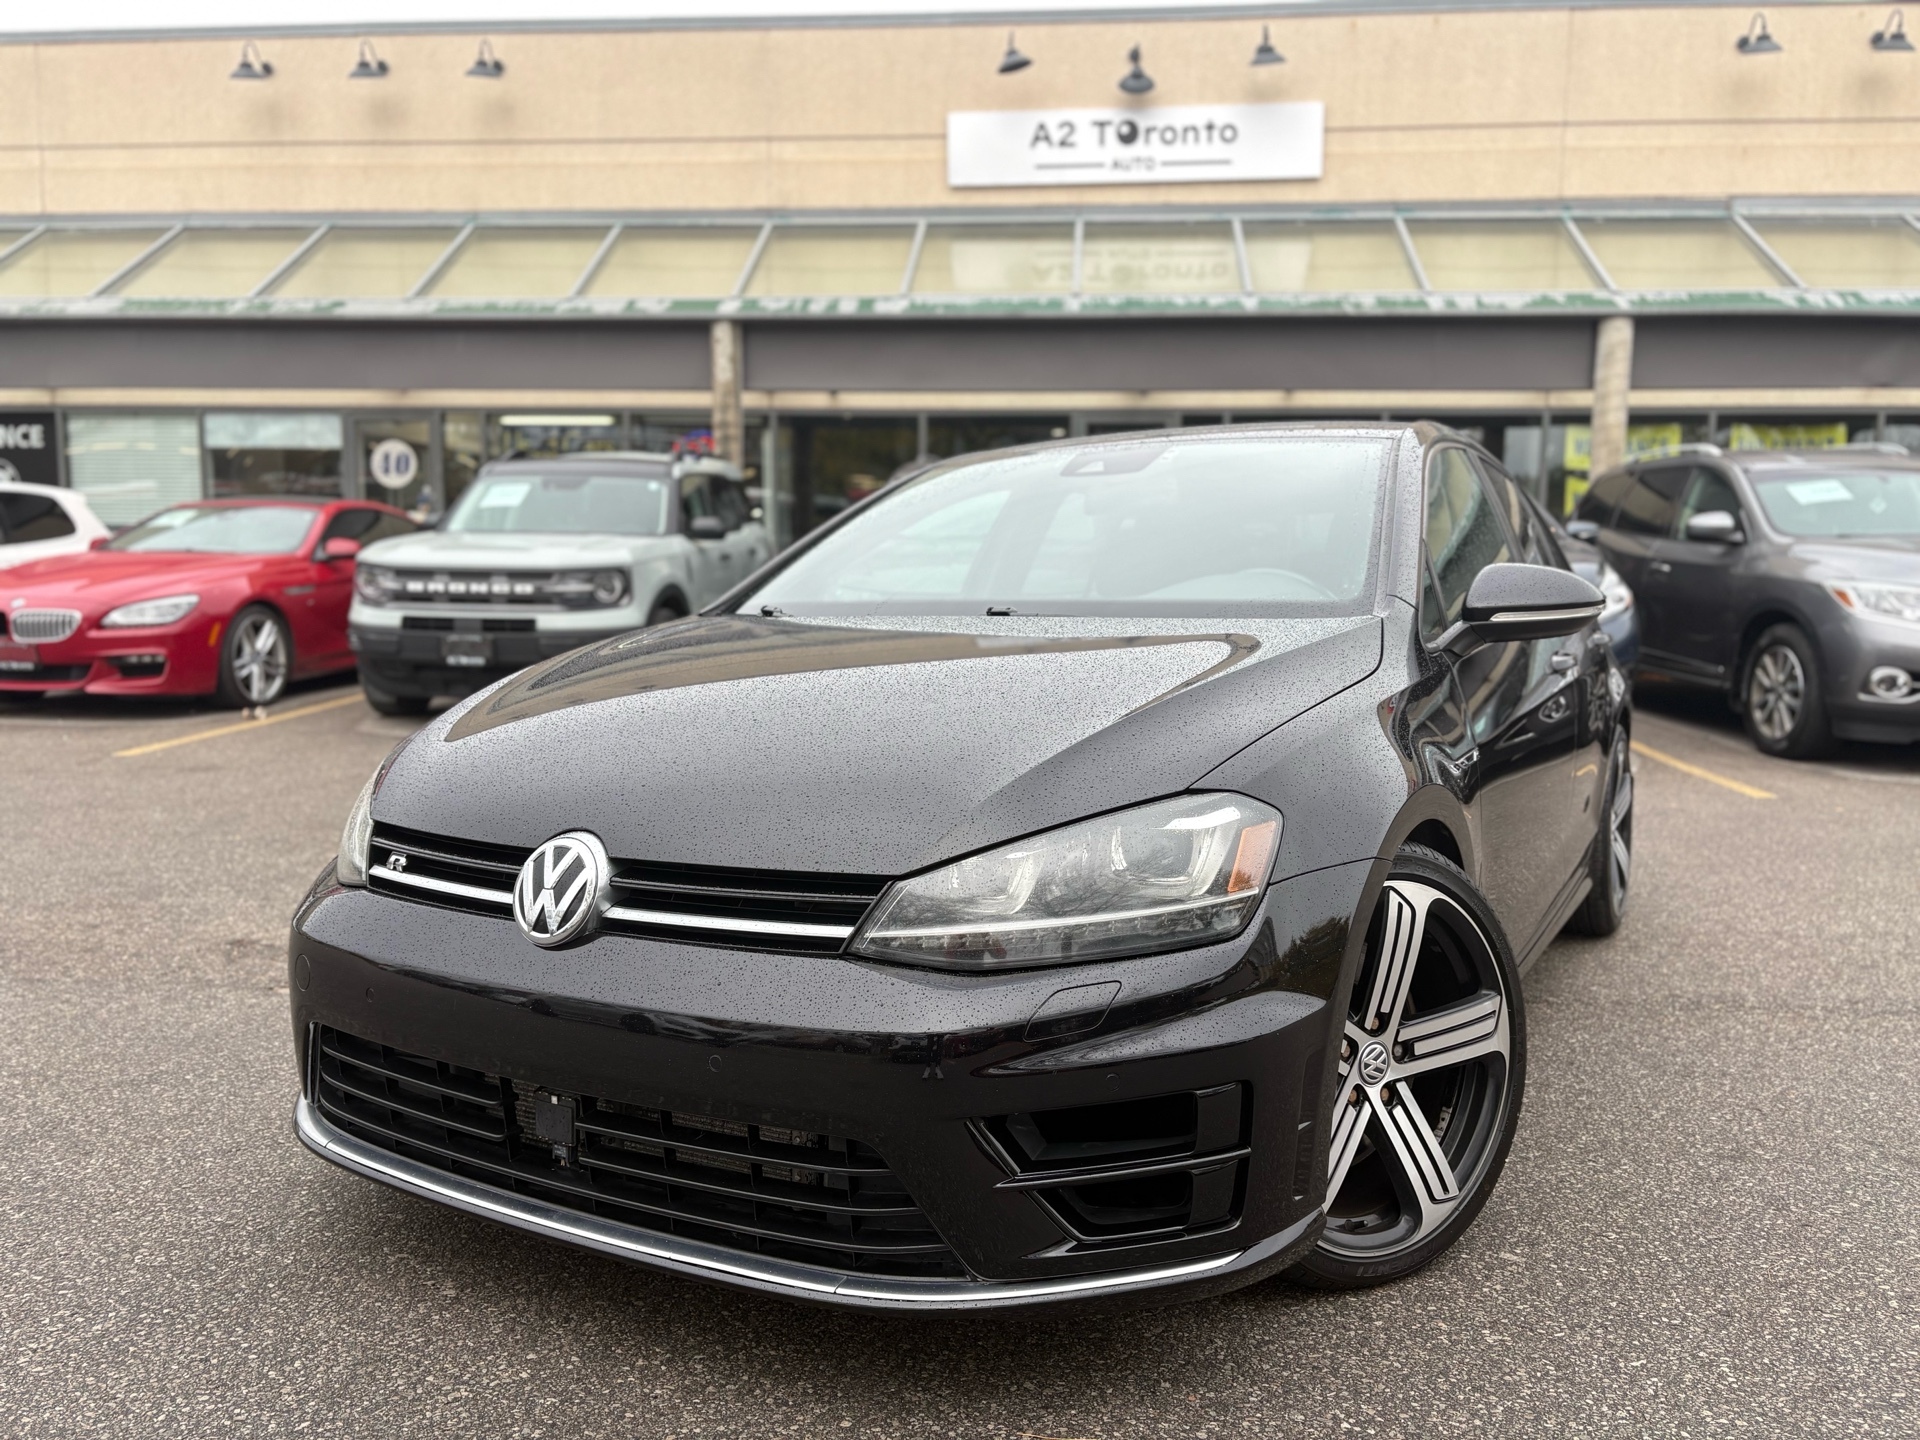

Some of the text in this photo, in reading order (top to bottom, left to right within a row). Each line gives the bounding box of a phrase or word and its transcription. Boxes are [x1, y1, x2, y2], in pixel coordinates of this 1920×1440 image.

[1031, 121, 1076, 148] A2
[1111, 155, 1157, 172] AUTO
[386, 851, 407, 873] R
